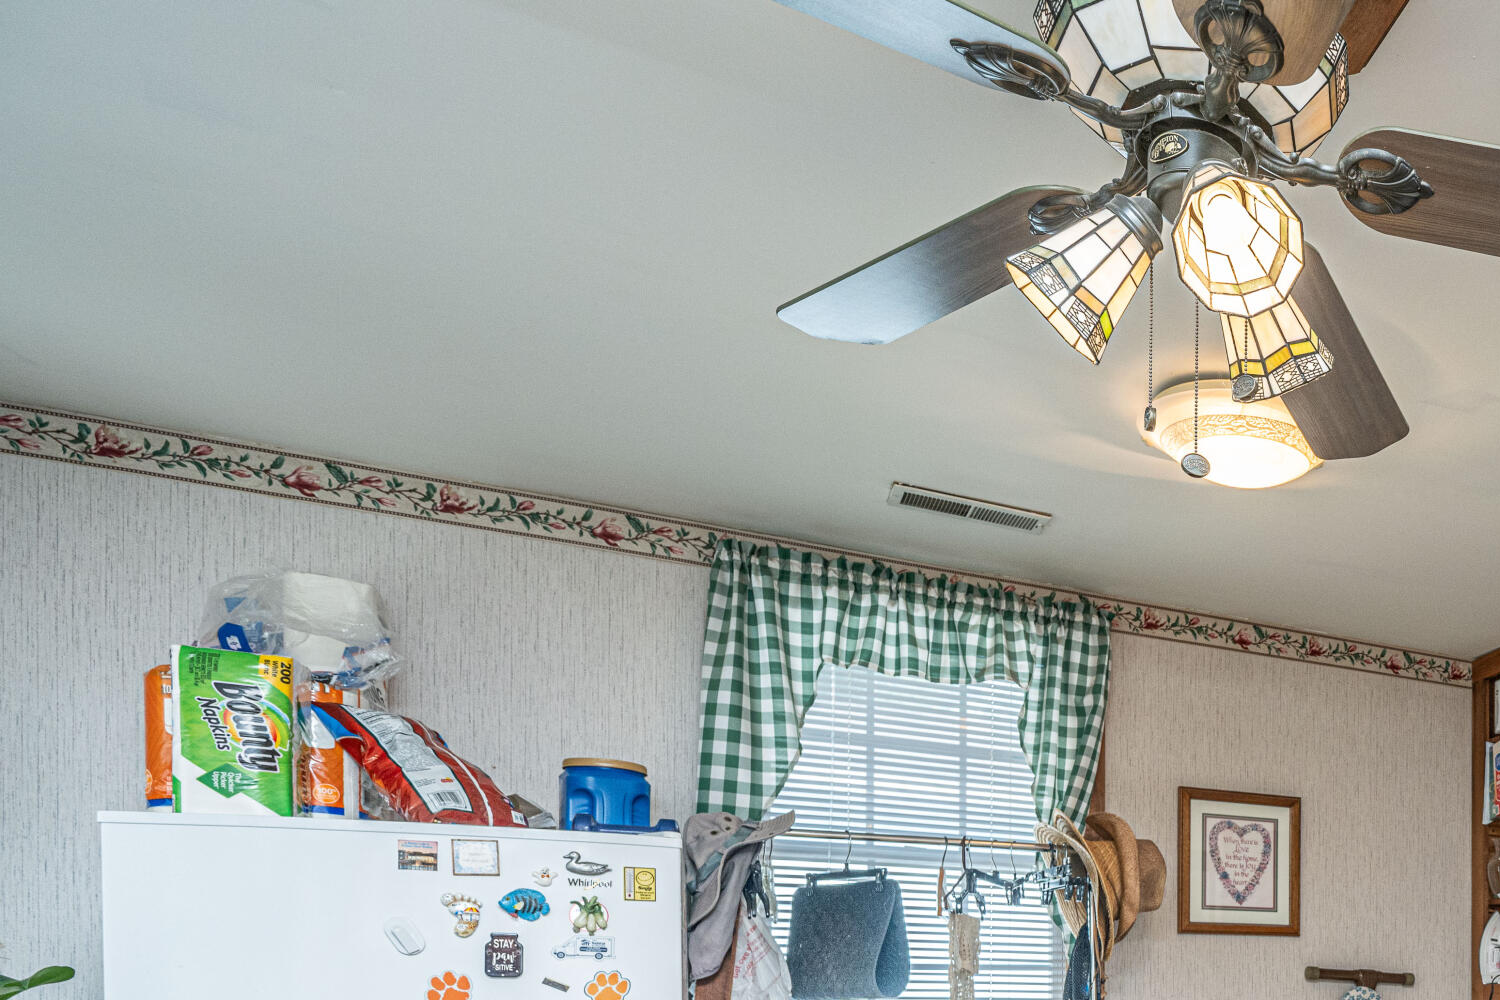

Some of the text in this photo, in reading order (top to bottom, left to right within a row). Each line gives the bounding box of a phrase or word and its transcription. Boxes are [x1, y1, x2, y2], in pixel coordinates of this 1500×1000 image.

[280, 662, 291, 684] 200
[195, 696, 231, 751] Napkins
[212, 681, 282, 772] Bounty
[568, 878, 612, 889] Whirlpool
[493, 938, 514, 949] STAY
[494, 964, 514, 972] SITIVE
